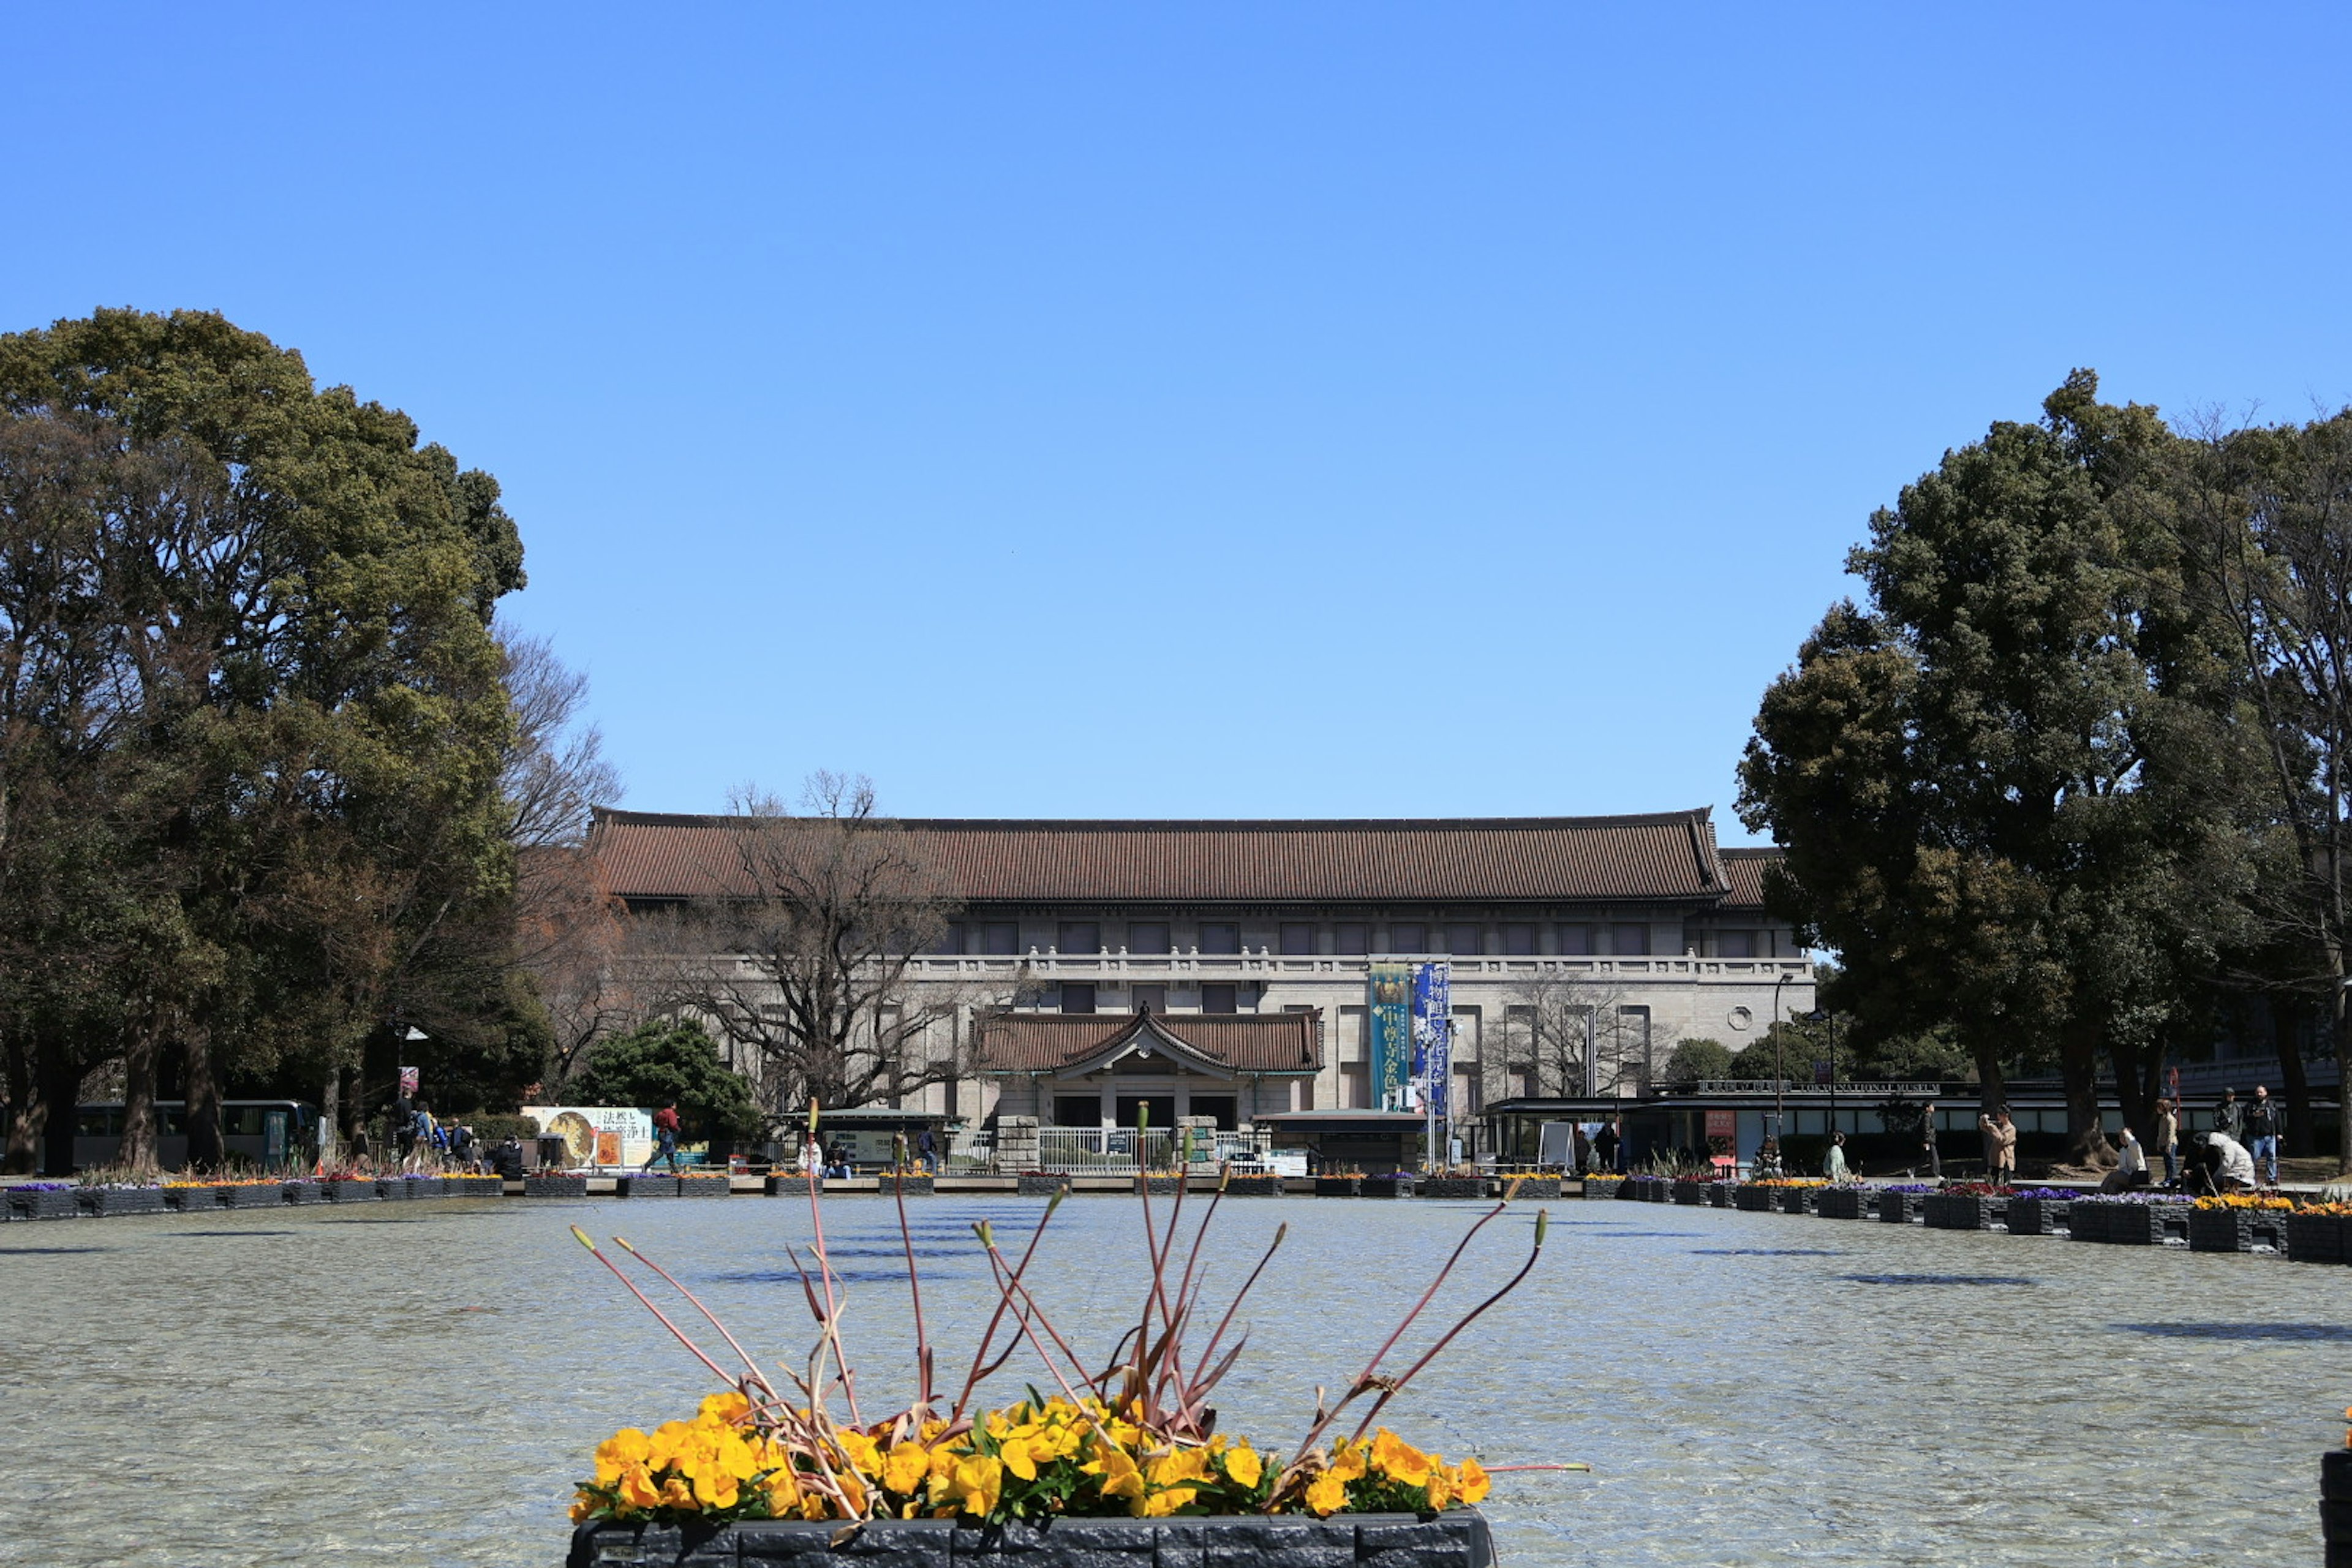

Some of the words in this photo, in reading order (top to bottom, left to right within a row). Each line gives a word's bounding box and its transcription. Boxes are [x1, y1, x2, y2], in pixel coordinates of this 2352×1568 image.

[1800, 1084, 1836, 1093] TOKYO
[1837, 1084, 1894, 1093] NATIONAL
[1896, 1084, 1941, 1093] MUSEUM
